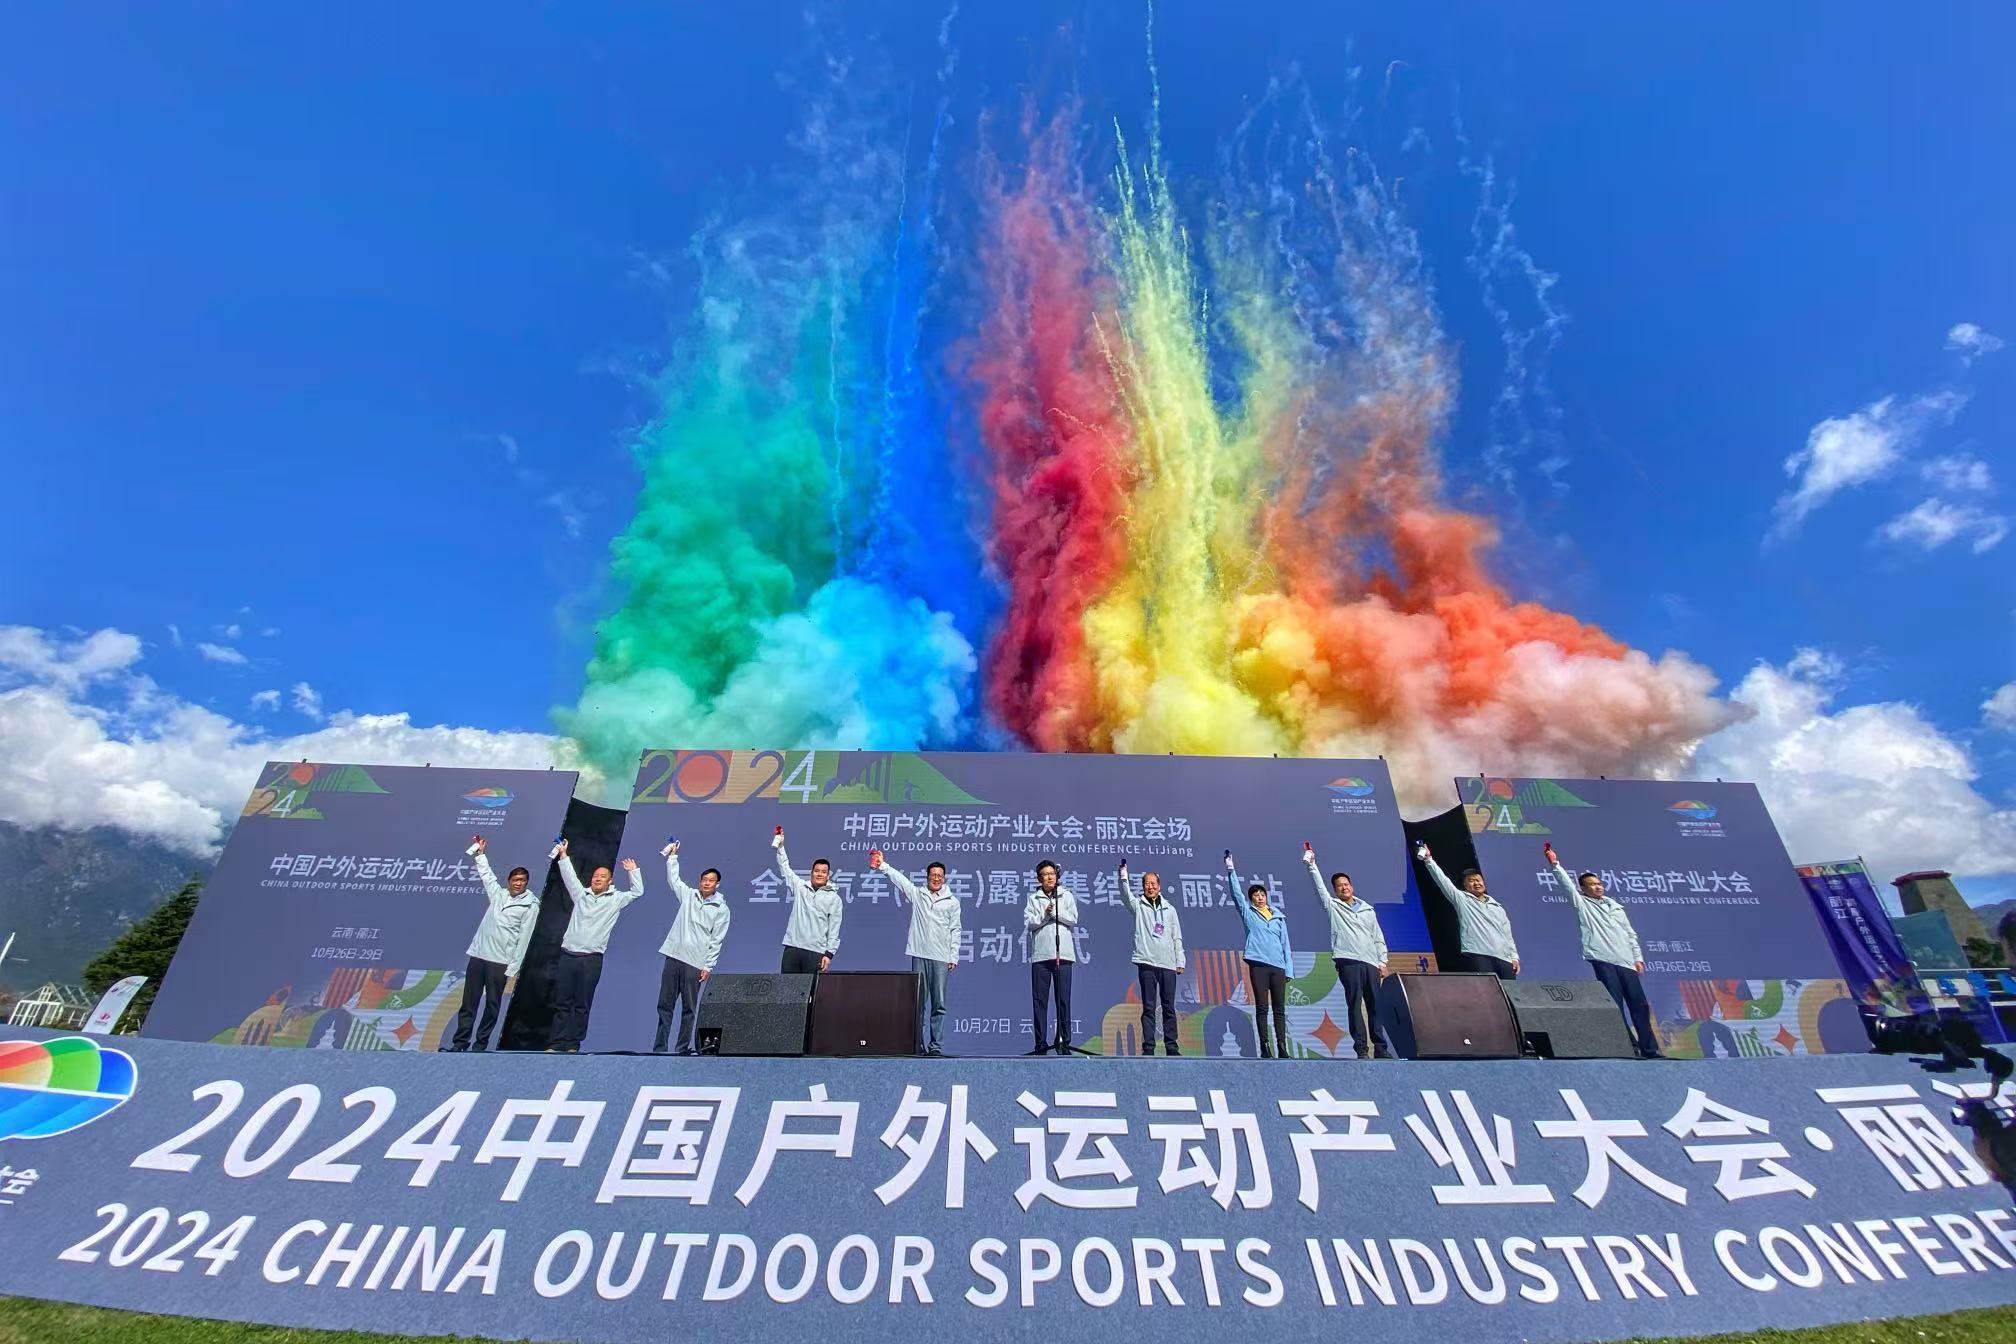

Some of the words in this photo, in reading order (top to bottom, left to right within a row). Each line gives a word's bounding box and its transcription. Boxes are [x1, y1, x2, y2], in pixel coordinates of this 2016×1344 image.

[843, 812, 1192, 841] 中国户外运动产业大会·丽江会场
[841, 842, 878, 852] CHINA
[882, 842, 943, 853] OUTDOOR
[946, 842, 993, 853] SPORTS
[997, 843, 1057, 854] INDUSTRY
[260, 879, 288, 889] CHINA
[292, 880, 338, 890] OUTDOOR
[340, 881, 376, 891] SPORTS
[378, 882, 425, 893] INDUSTRY
[1621, 896, 1655, 905] SPORTS
[1656, 897, 1701, 906] INDUSTRY
[1704, 897, 1761, 906] CONFERENCE
[331, 926, 380, 939] 云南·丽江
[953, 1017, 1011, 1034] 10月27日
[57, 1203, 257, 1277] 2024
[261, 1219, 507, 1295] CHINA
[532, 1230, 936, 1304] OUTDOOR
[965, 1236, 1284, 1308] SPORTS
[1305, 1232, 1699, 1306] INDUSTRY
